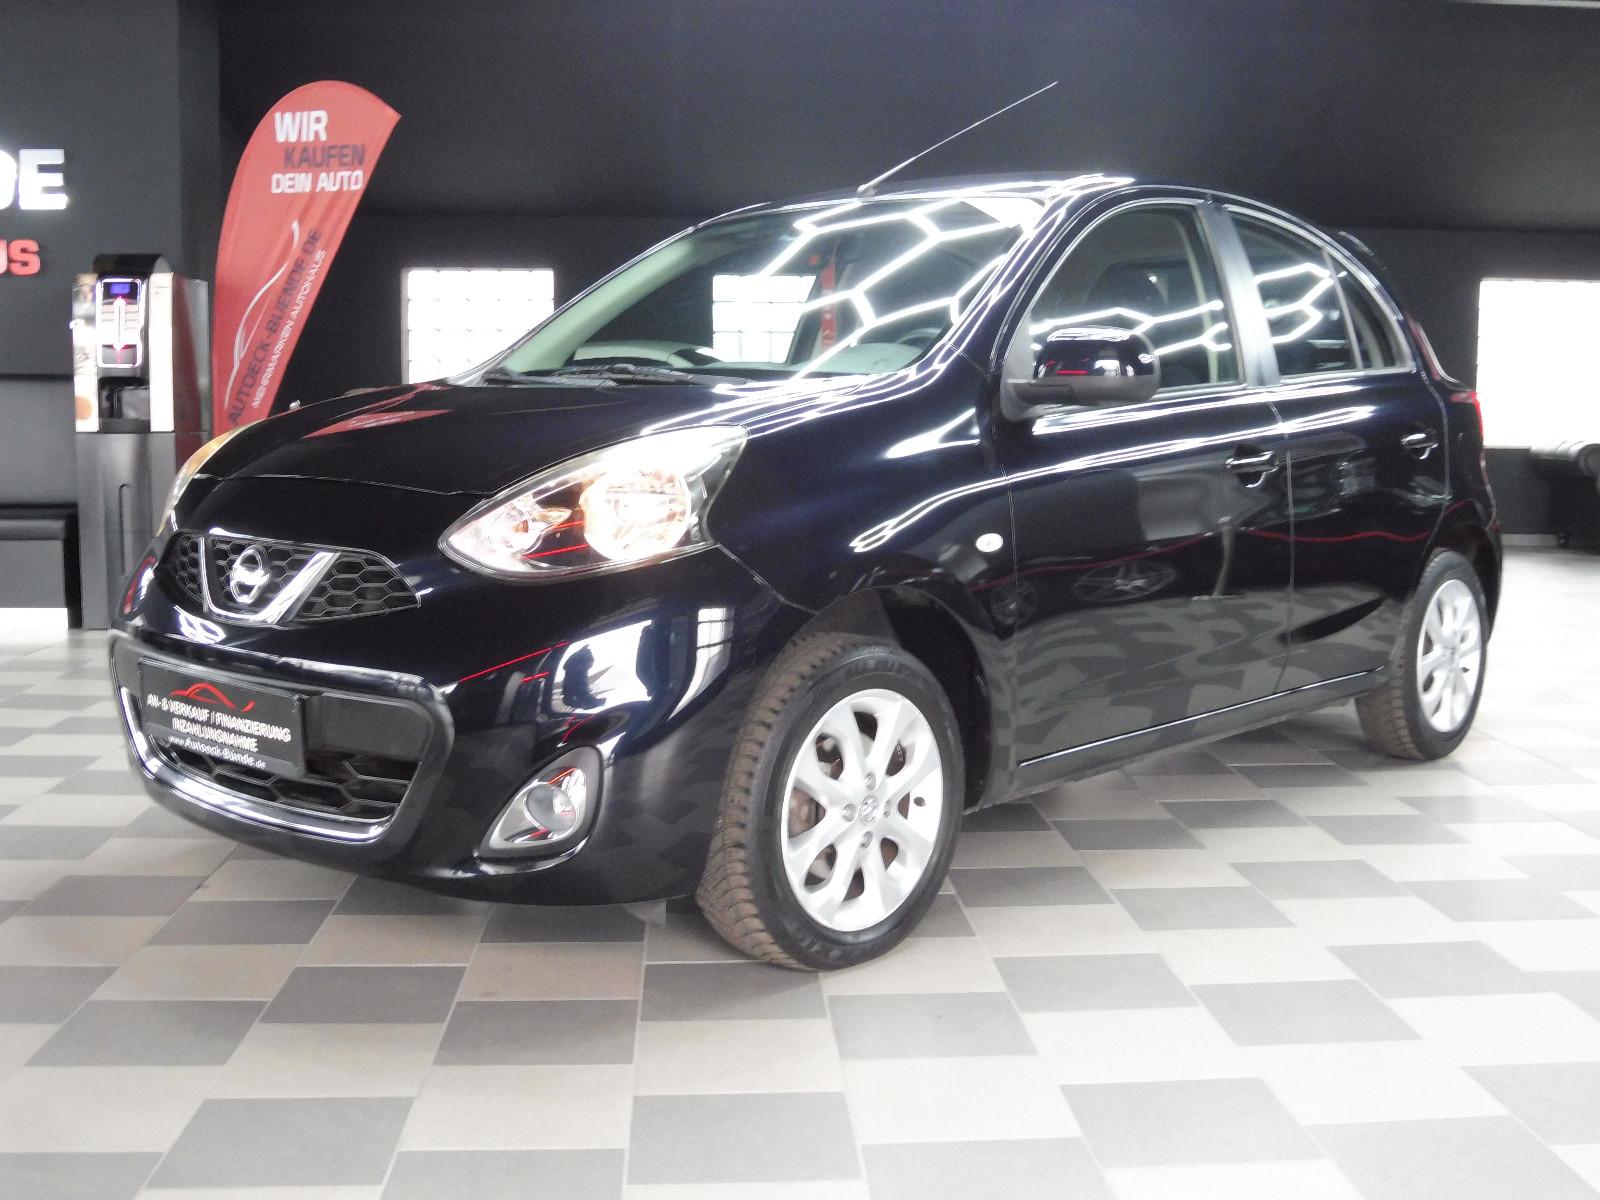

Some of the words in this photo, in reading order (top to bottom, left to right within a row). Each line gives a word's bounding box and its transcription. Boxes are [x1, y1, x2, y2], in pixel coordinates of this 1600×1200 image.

[274, 110, 328, 143] WIR
[284, 144, 365, 169] KAUFEN
[271, 172, 312, 194] DEIN
[316, 170, 364, 193] AUTO
[0, 239, 41, 276] S
[251, 319, 295, 409] MEHRMARKEN
[291, 248, 327, 320] AUTOHAUS
[215, 711, 292, 742] FINANZIERUNG
